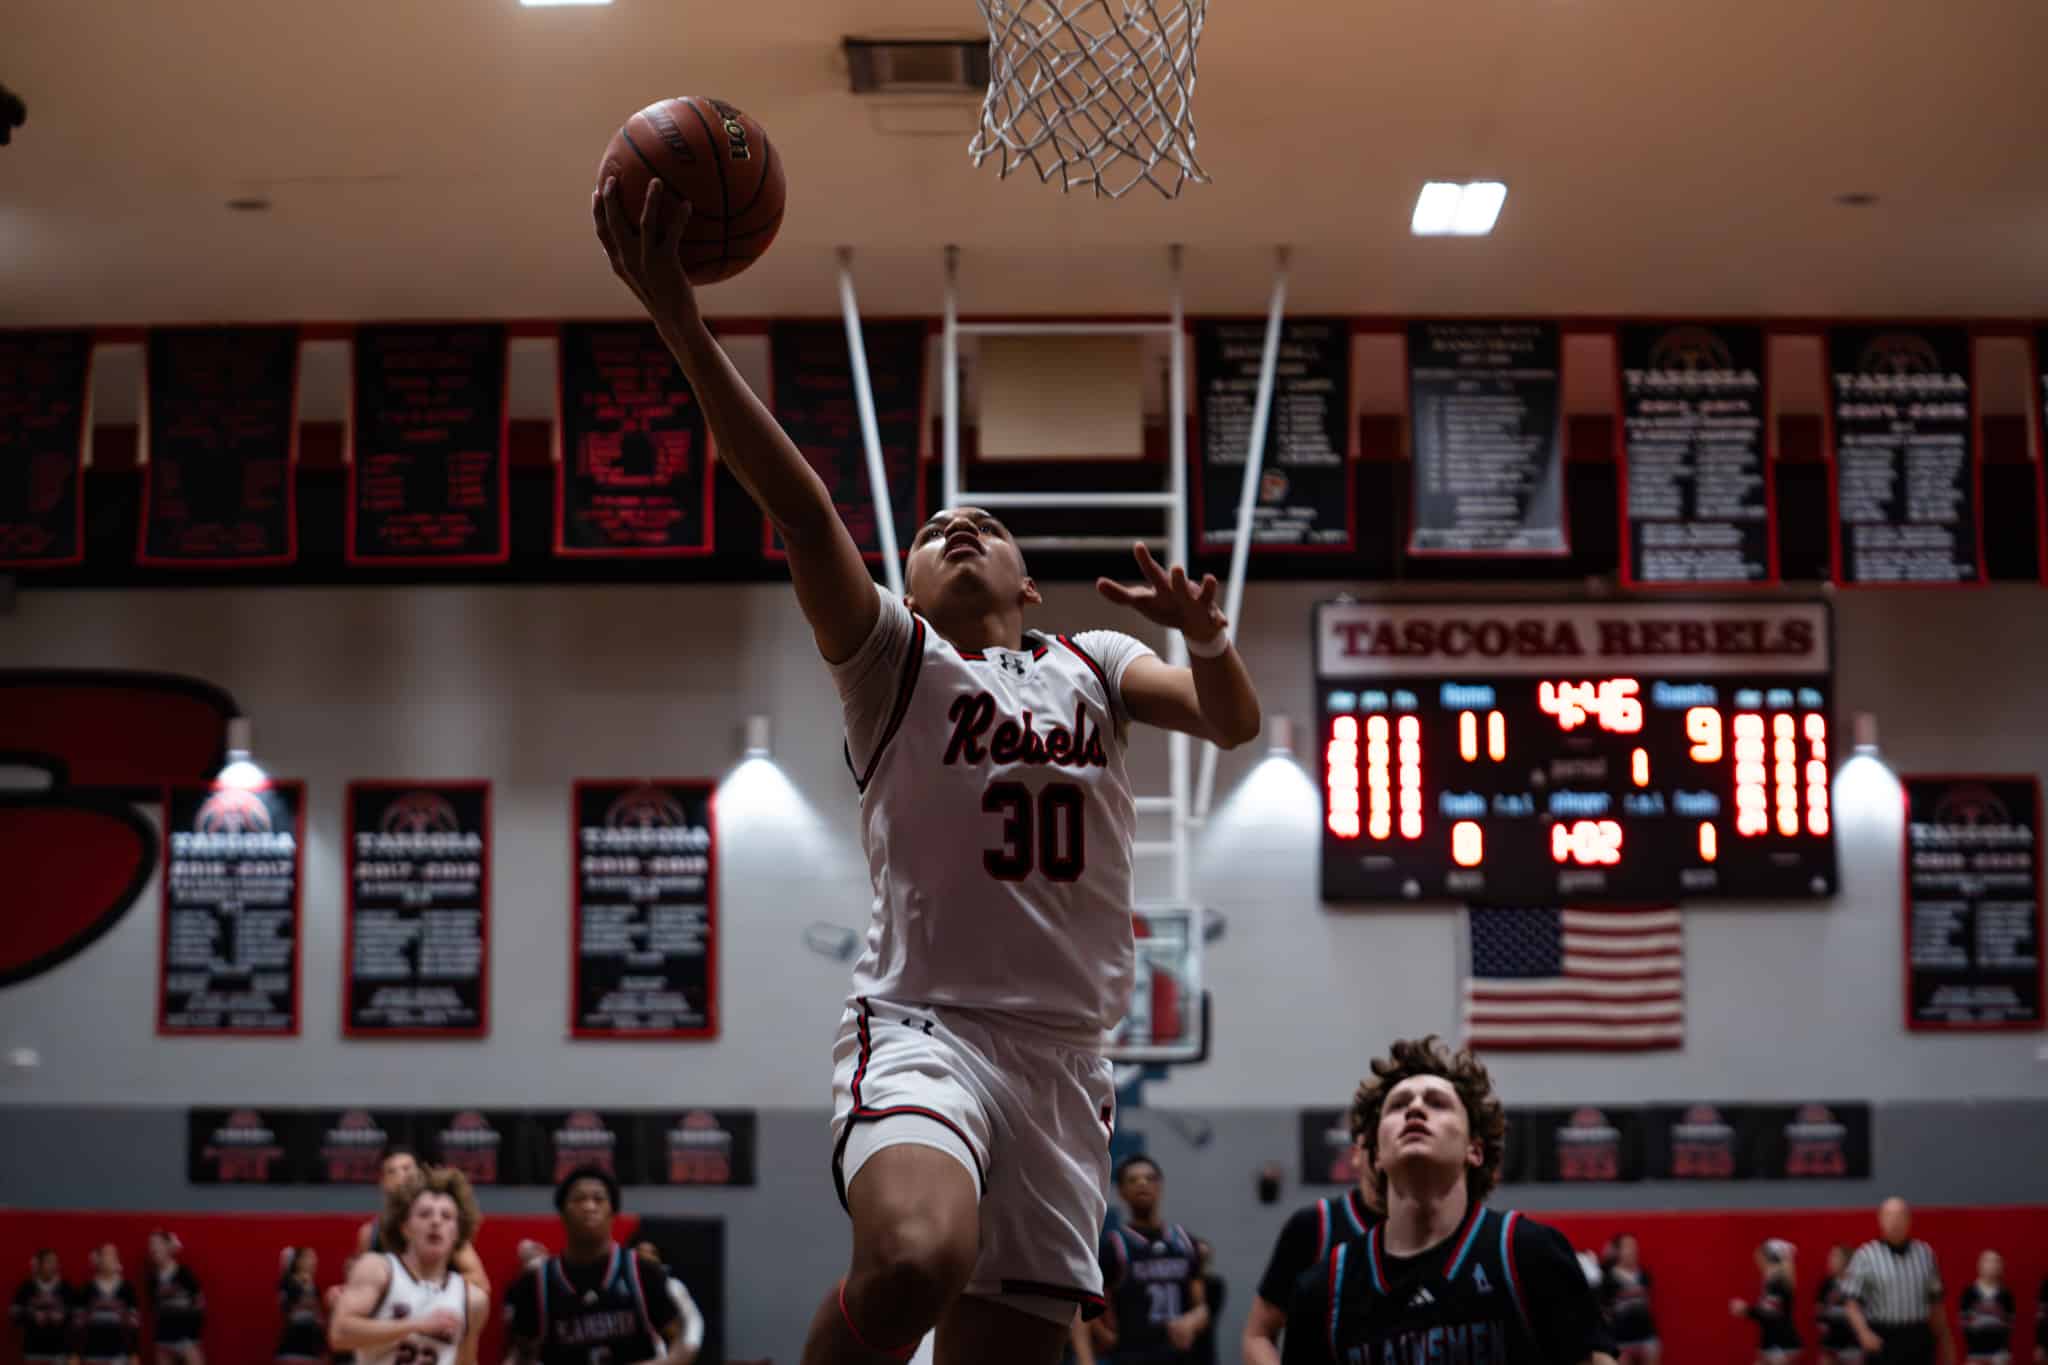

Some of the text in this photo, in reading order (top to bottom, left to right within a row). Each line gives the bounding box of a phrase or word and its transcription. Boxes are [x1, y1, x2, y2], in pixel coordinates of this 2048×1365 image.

[1334, 618, 1814, 659] TASCOSA REBELS
[943, 690, 1108, 769] Rebels
[1686, 706, 1723, 763] 9
[981, 781, 1086, 882] 30
